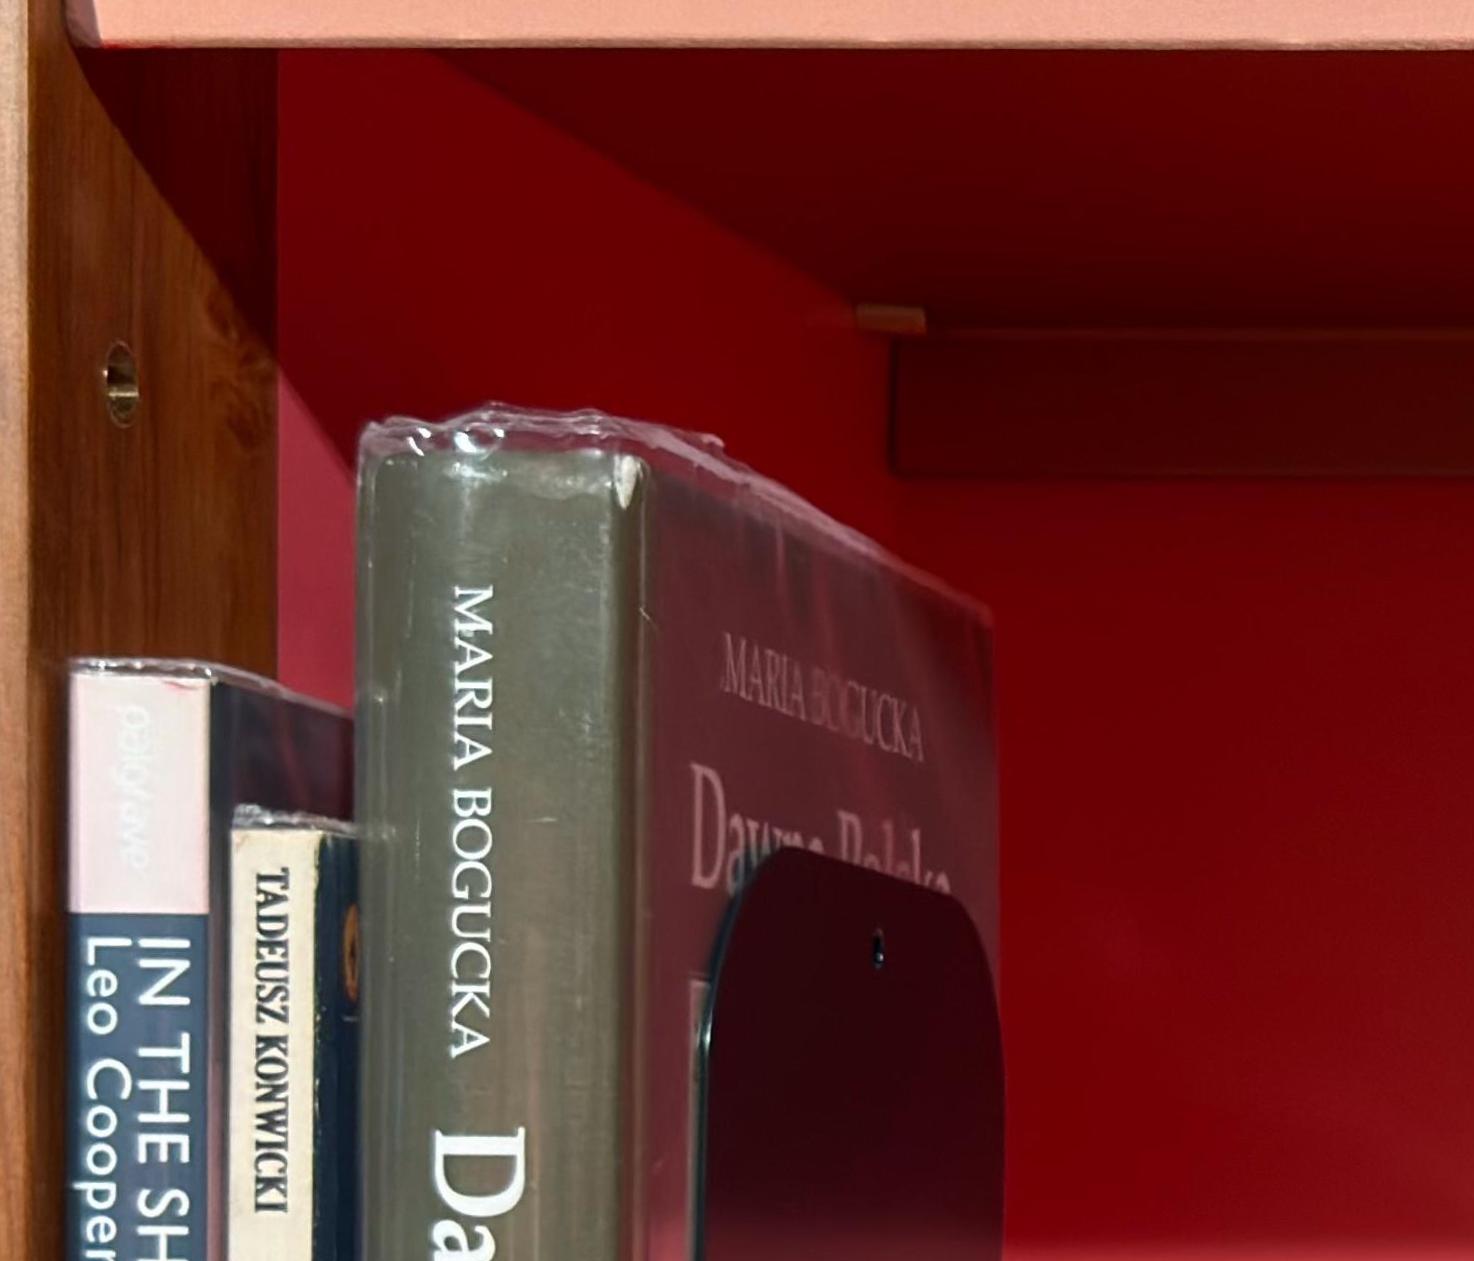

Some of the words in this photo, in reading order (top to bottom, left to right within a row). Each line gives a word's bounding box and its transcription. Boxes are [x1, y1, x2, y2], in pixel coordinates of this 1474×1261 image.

[451, 585, 494, 771] MARIA
[719, 630, 807, 722] MARIA
[810, 664, 925, 764] BOGUCKA
[85, 936, 133, 1036] Leo
[136, 936, 192, 1007] IN
[254, 866, 290, 1024] TADEUSZ
[449, 786, 494, 1060] BOGUCKA
[136, 1031, 191, 1165] THE
[253, 1033, 289, 1213] KONWICKI
